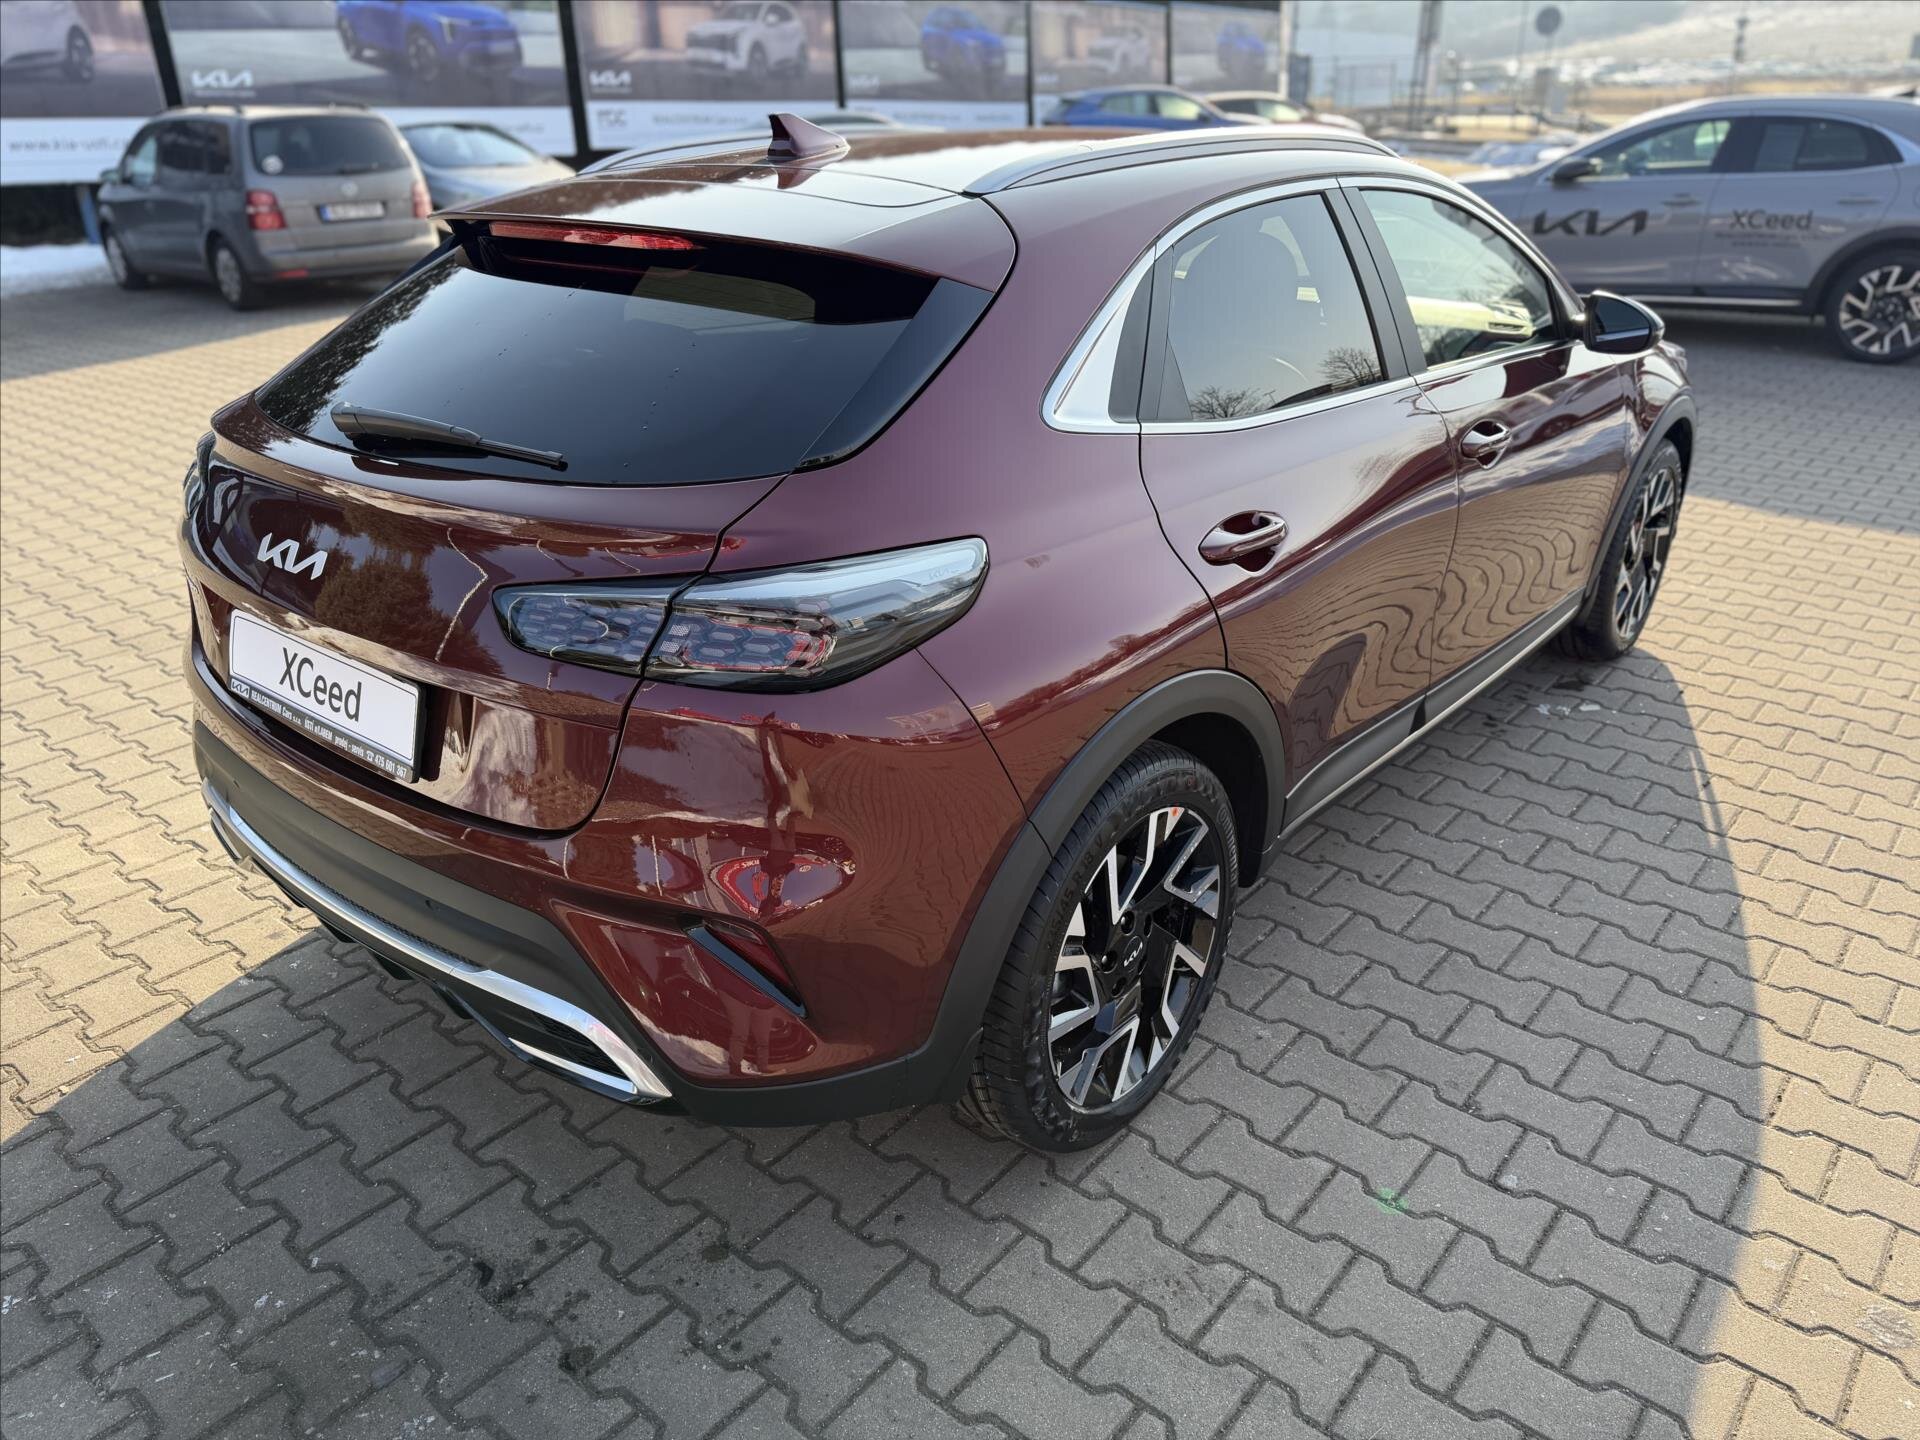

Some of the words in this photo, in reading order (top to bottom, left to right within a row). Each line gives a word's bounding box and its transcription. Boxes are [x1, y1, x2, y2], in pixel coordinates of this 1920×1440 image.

[1533, 209, 1649, 236] KIA
[1730, 208, 1814, 231] XCeed
[257, 532, 328, 580] KIA
[279, 647, 362, 722] XCeed
[232, 681, 249, 696] KIA
[374, 754, 385, 768] 475
[385, 759, 395, 773] 601
[1123, 941, 1143, 967] KIA
